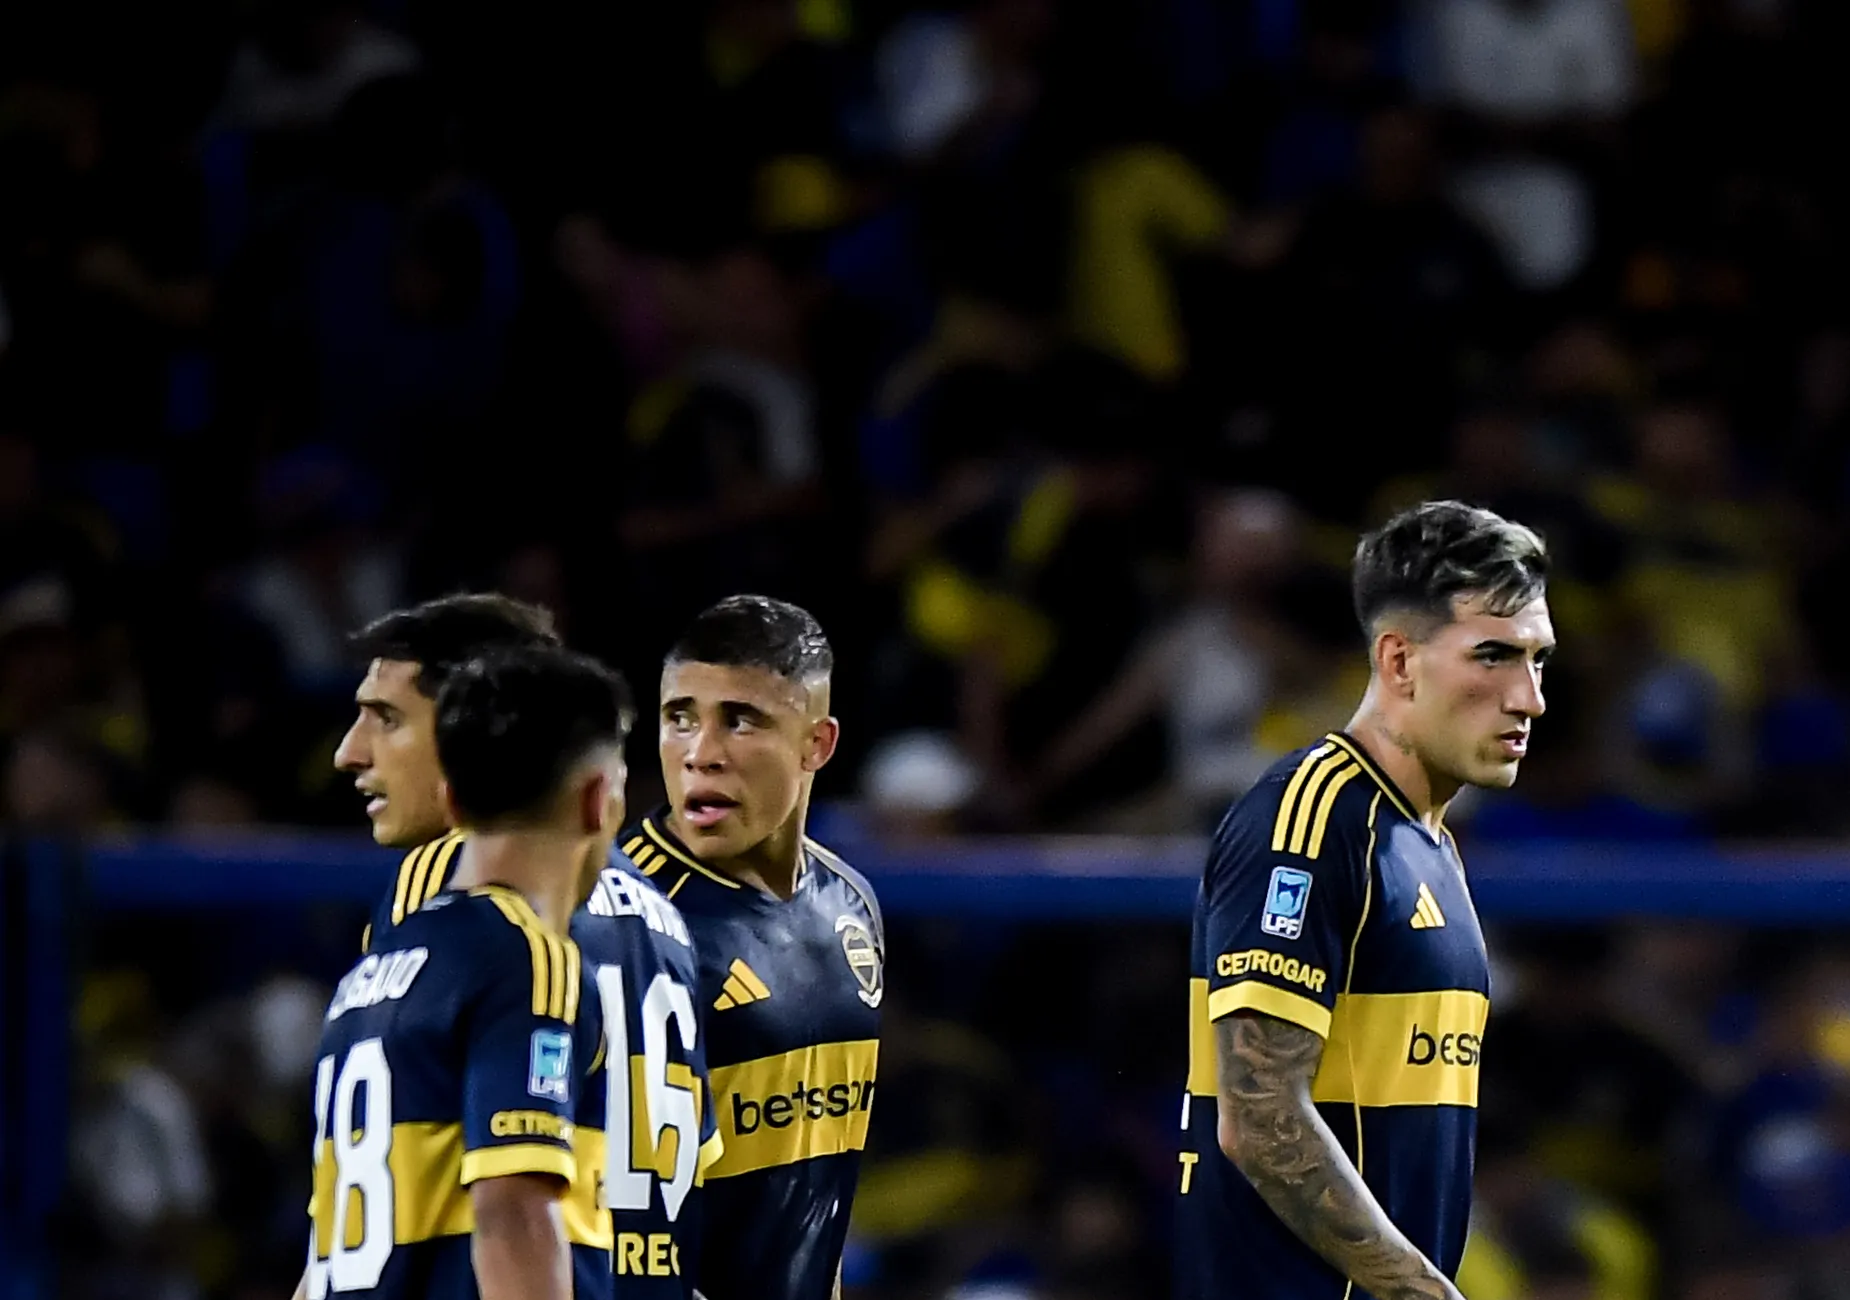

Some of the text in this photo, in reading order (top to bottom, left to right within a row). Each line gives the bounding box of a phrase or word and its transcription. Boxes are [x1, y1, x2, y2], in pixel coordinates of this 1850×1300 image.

[1266, 914, 1300, 936] LPF
[1216, 949, 1327, 994] CETROGAR
[598, 963, 697, 1222] 16
